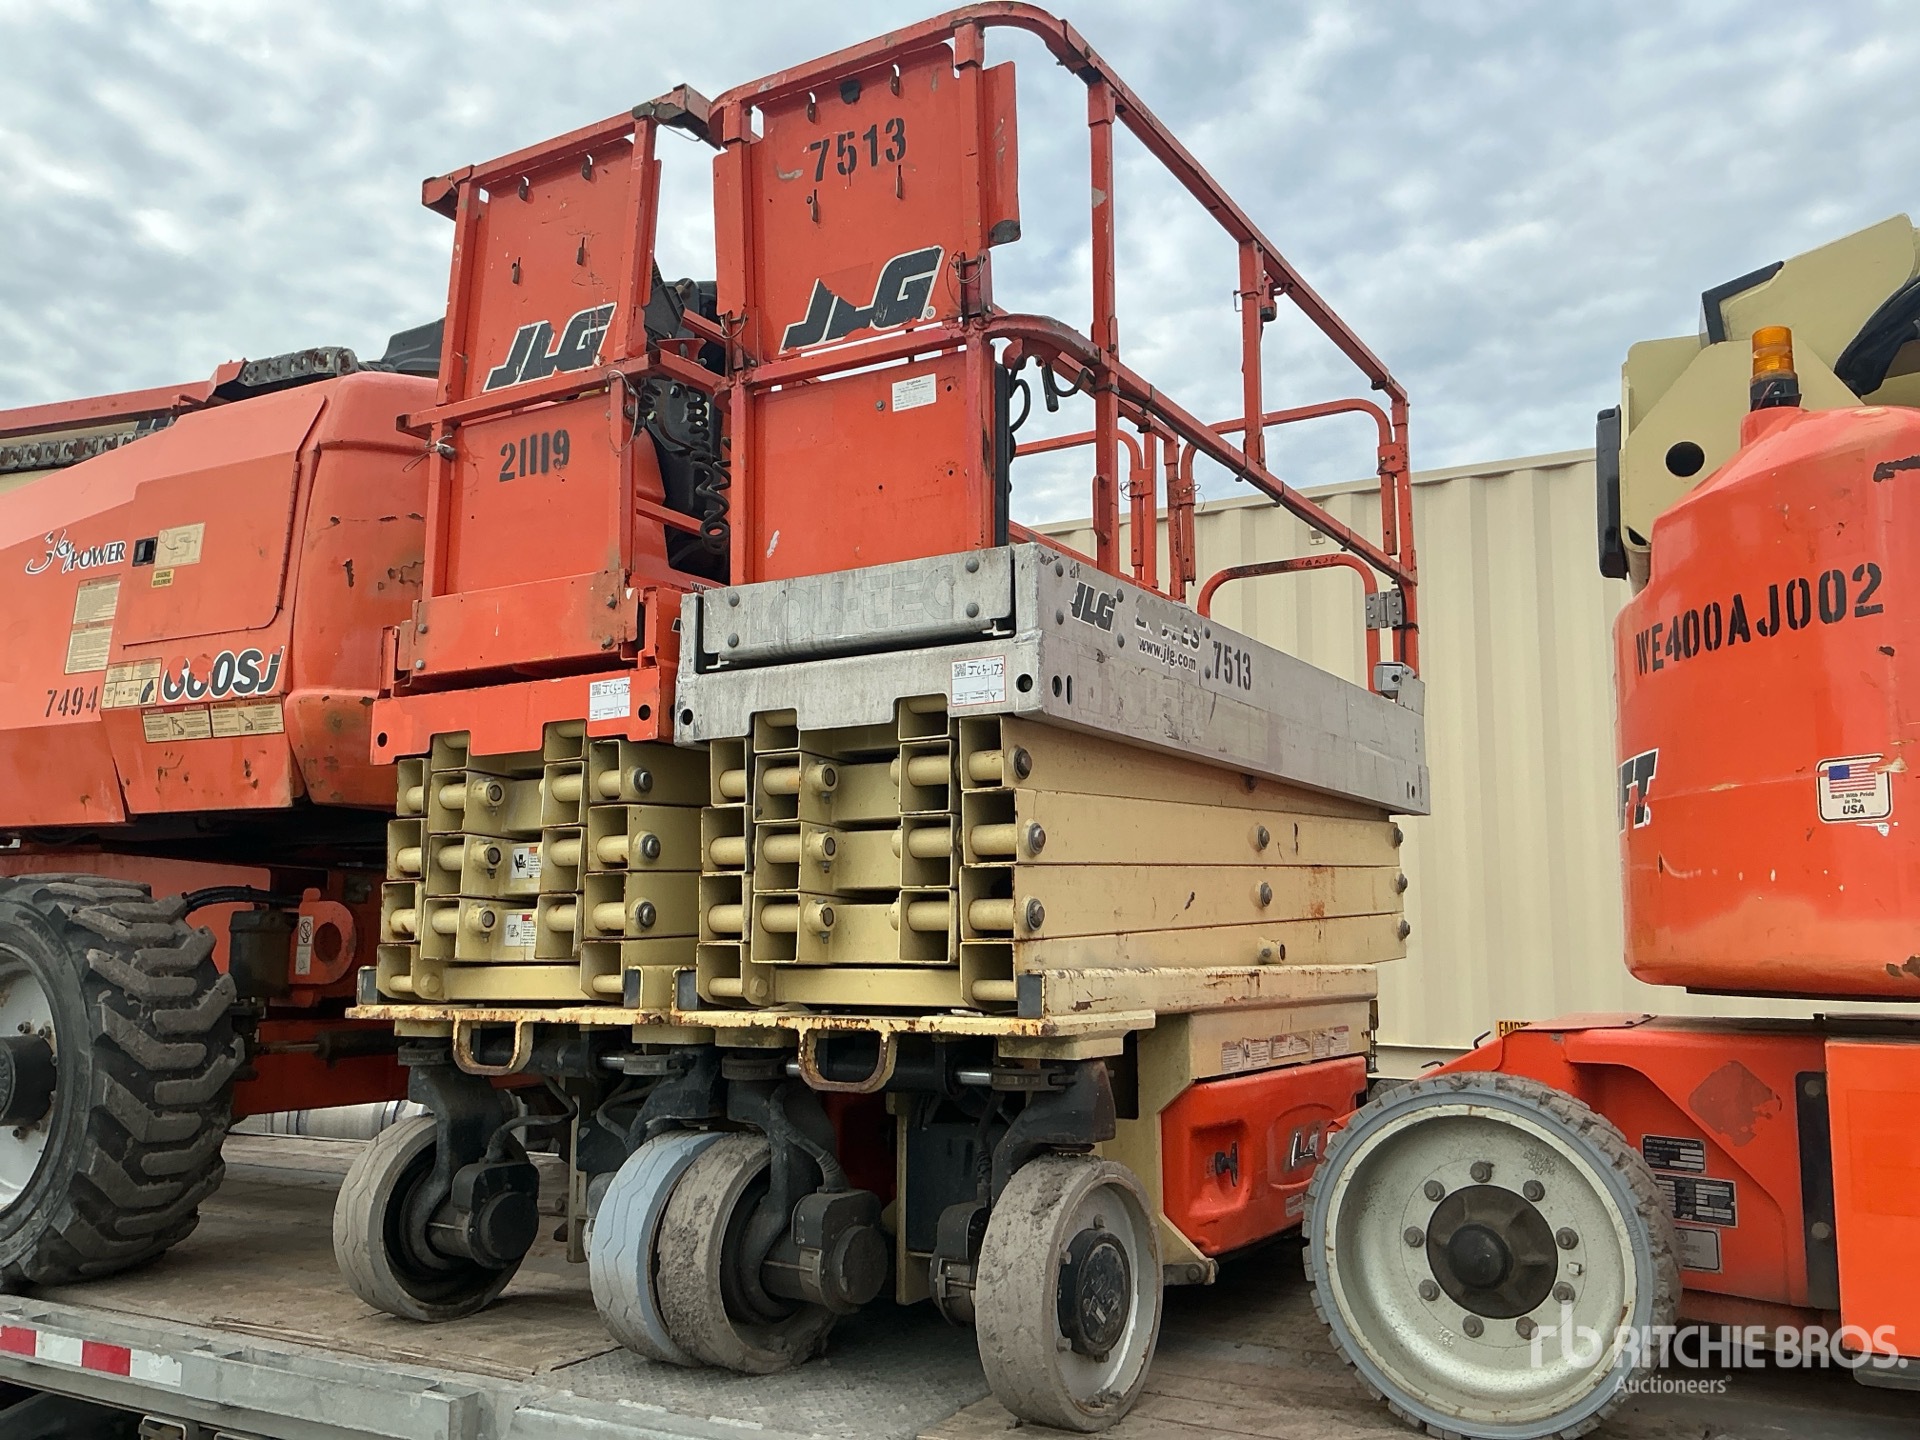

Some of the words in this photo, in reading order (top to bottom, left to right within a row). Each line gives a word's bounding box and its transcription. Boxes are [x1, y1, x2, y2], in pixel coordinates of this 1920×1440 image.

[809, 117, 907, 183] 7513
[778, 245, 946, 355] JLG
[481, 301, 617, 393] JLG
[499, 429, 570, 482] 21119
[1069, 580, 1117, 633] JLG
[1636, 562, 1884, 677] WE400AJ002
[1138, 636, 1197, 673] www.jlg.com
[1212, 640, 1252, 691] 7513
[45, 685, 99, 718] 7494
[1842, 804, 1865, 814] USA
